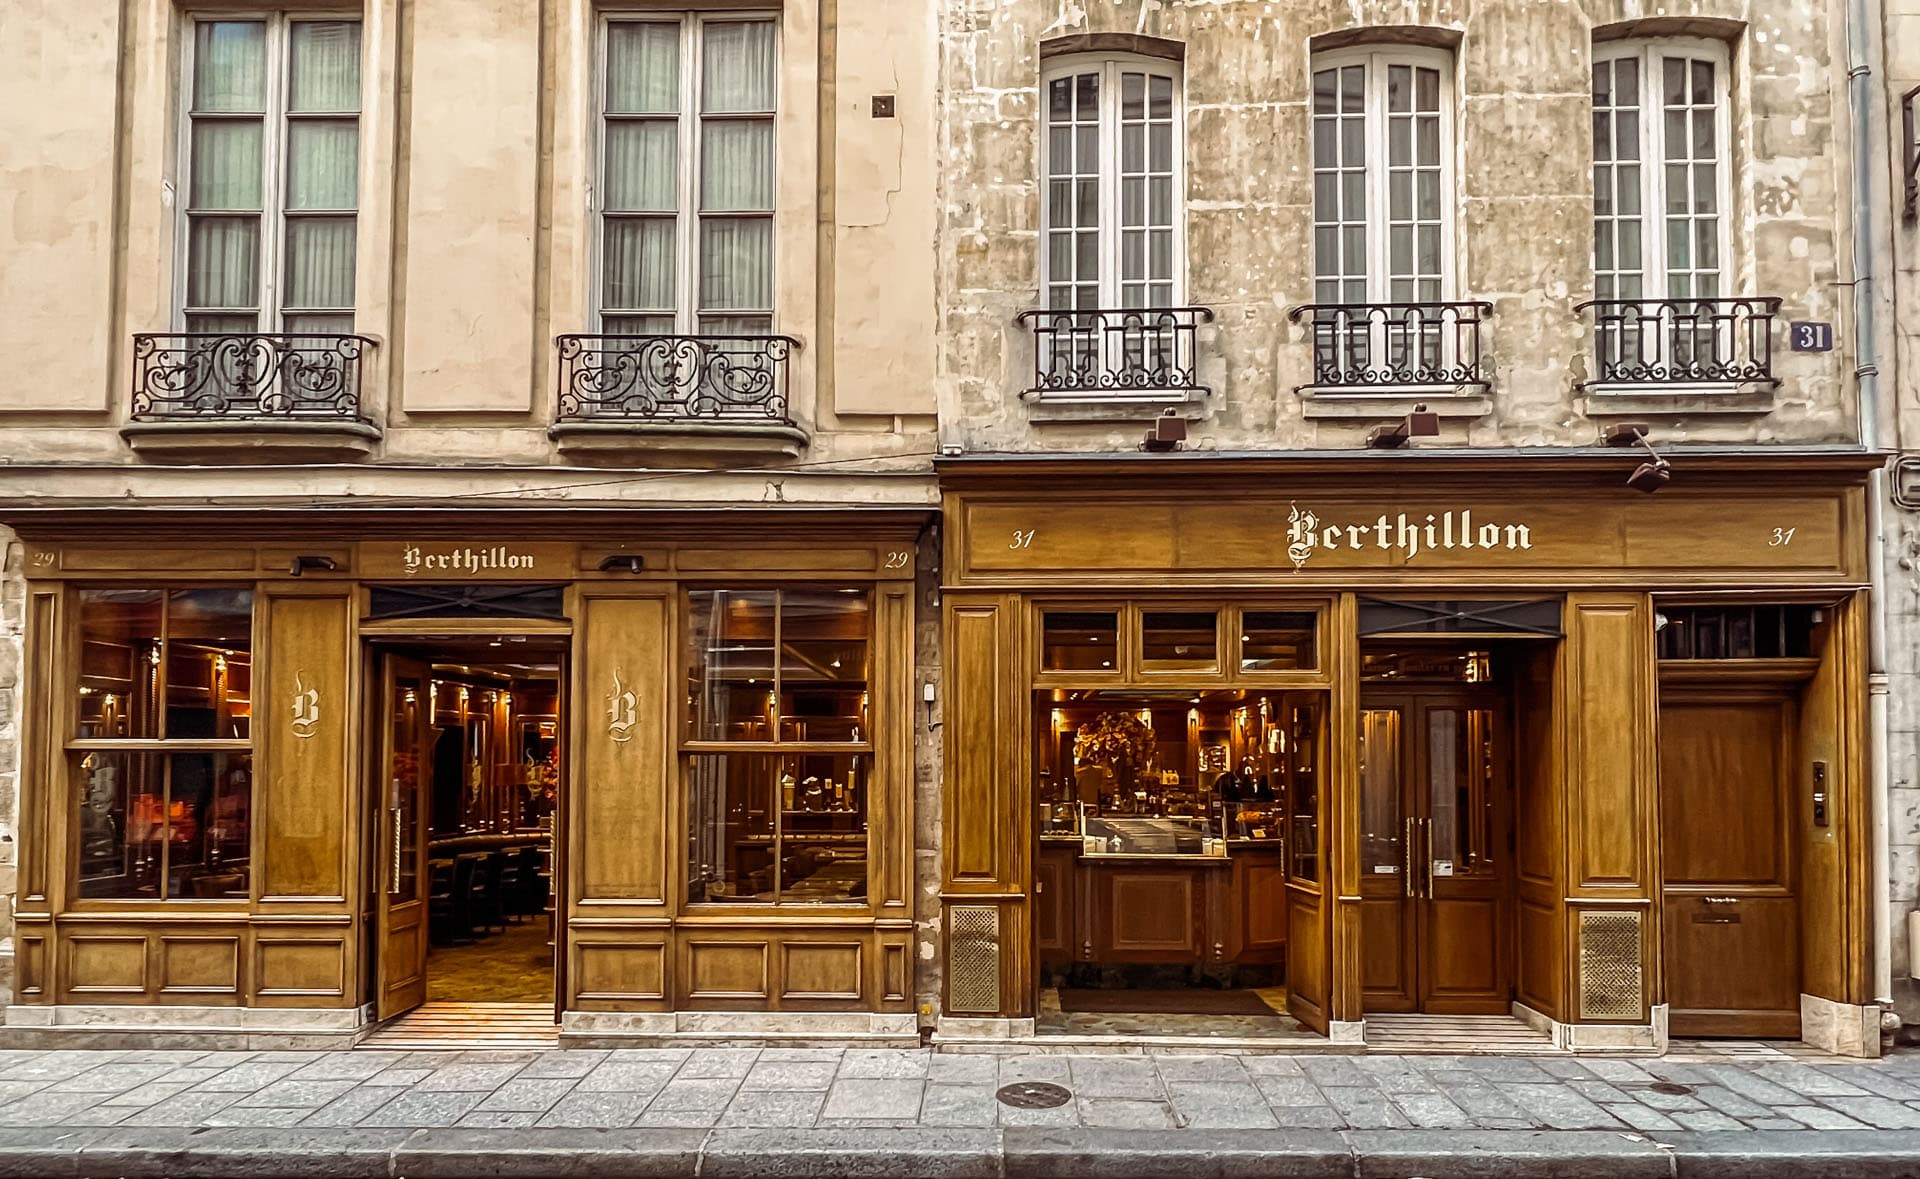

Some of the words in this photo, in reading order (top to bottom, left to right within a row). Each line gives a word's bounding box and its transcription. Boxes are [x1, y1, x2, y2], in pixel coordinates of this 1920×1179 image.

[1800, 325, 1824, 348] 31
[1009, 529, 1036, 549] 31
[1286, 499, 1533, 575] Berthillon
[1768, 527, 1796, 547] 31
[32, 551, 56, 568] 29
[403, 542, 534, 578] Berthillon
[884, 551, 908, 569] 29
